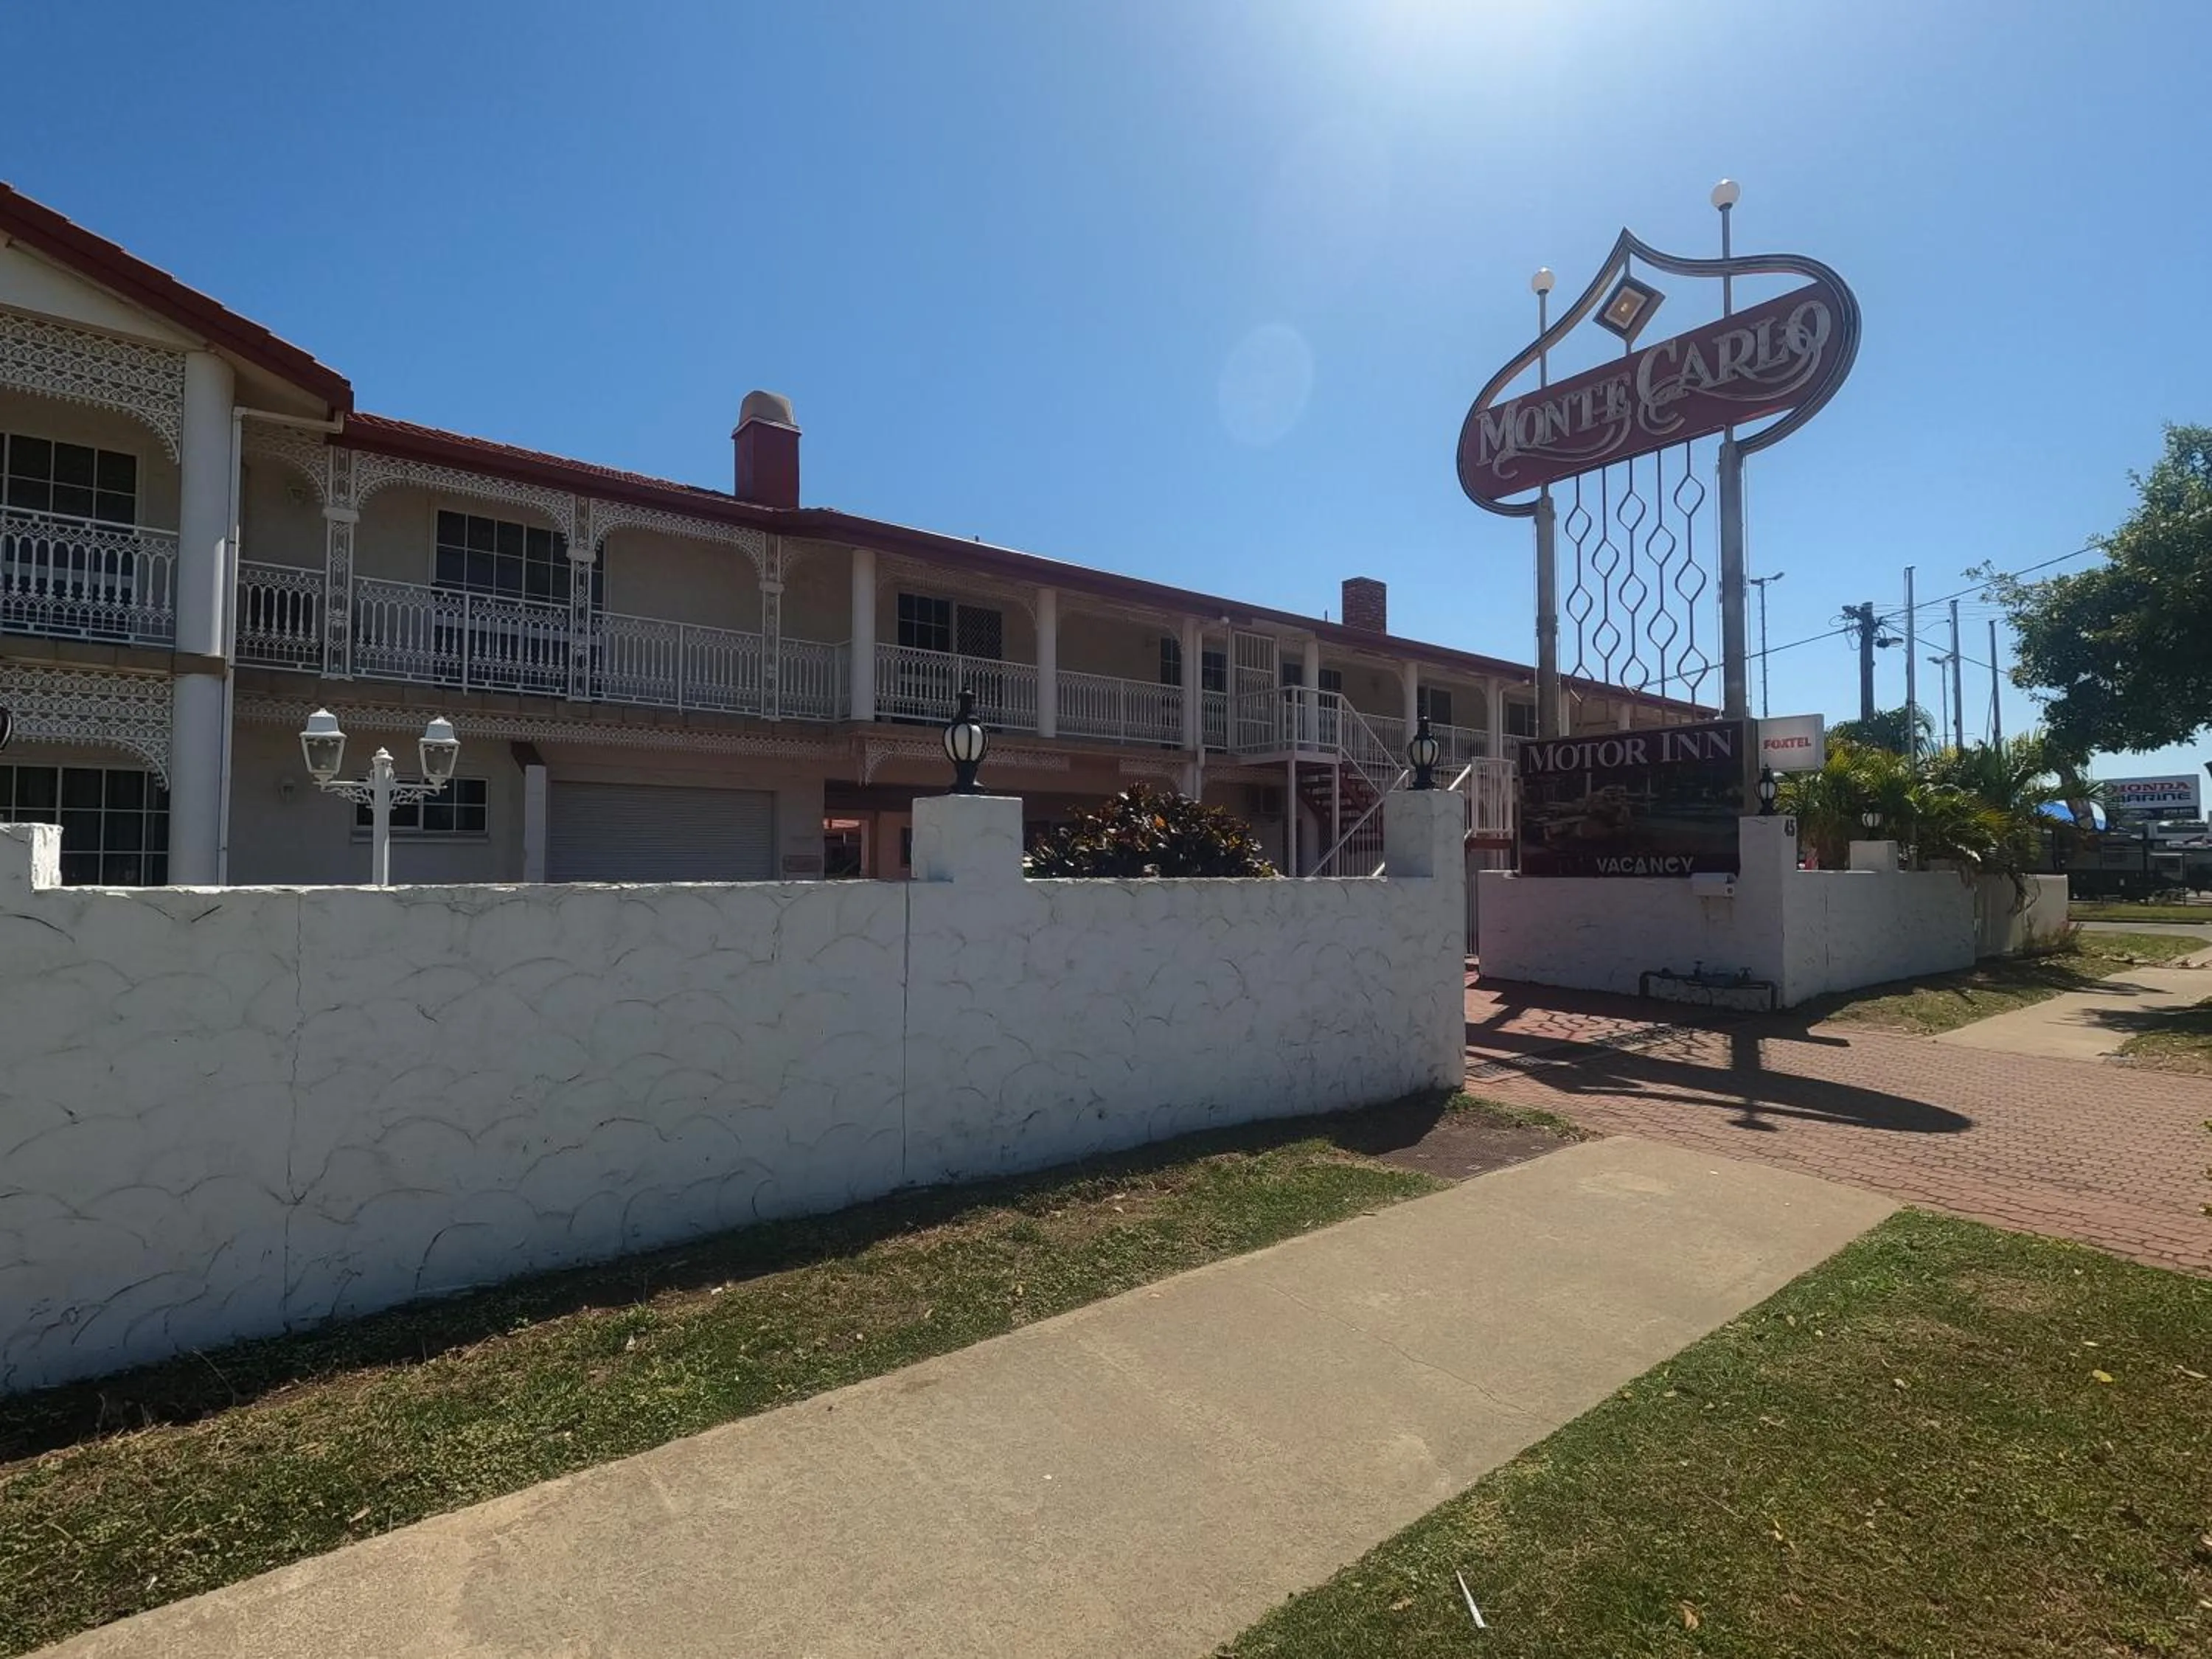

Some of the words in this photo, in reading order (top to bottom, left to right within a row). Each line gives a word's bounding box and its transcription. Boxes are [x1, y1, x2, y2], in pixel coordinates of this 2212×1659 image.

[1476, 371, 1631, 479] MONTE
[1637, 299, 1832, 435] CARLO
[1528, 738, 1648, 773] MOTOR
[1661, 729, 1732, 762] INN
[1763, 736, 1812, 750] FOXTEL
[1596, 855, 1694, 875] VACANCY
